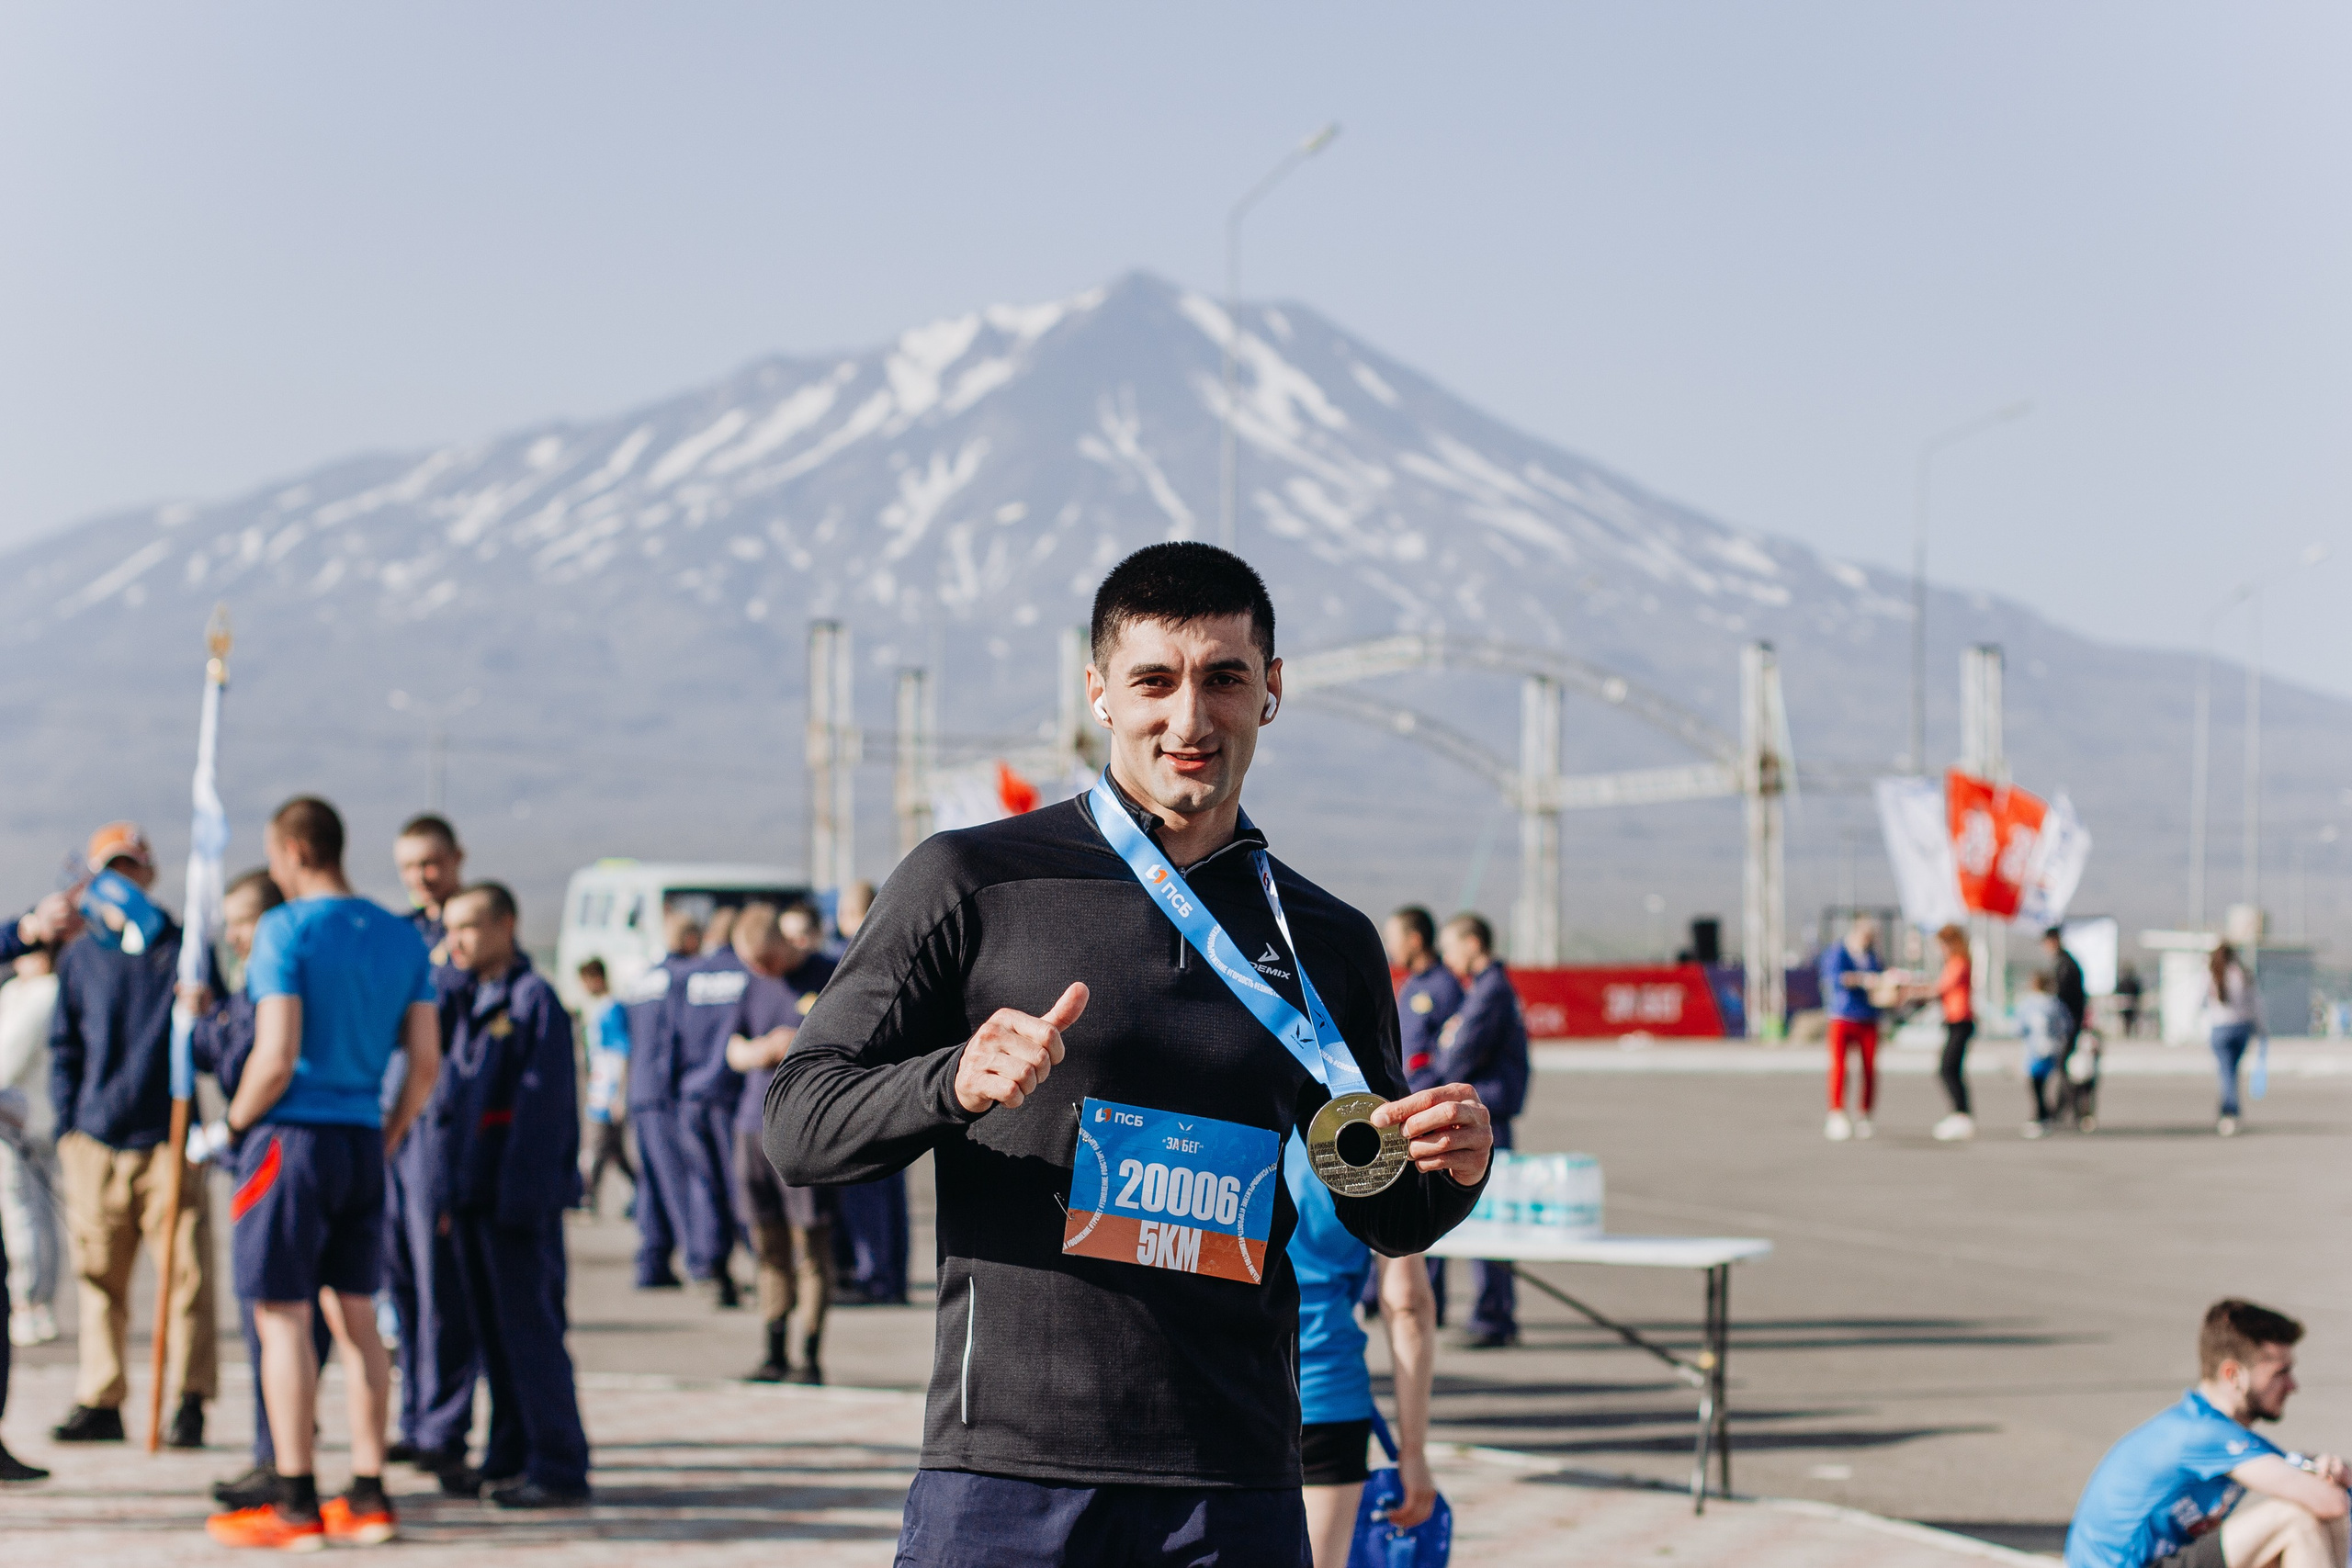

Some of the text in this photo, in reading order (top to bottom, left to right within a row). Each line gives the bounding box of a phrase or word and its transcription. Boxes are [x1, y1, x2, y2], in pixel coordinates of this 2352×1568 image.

[1160, 882, 1193, 918] ПСБ
[1227, 967, 1255, 989] #ГОРДОСТЬ
[1114, 1111, 1144, 1127] ПСБ
[1089, 1208, 1103, 1229] #ТРЕПЕТ
[1096, 1150, 1108, 1176] #ВОСТОРГ
[1114, 1158, 1241, 1225] 20006
[1237, 1207, 1246, 1237] #ГОРДОСТЬ
[1238, 1236, 1251, 1267] #ЕДИНСТВО
